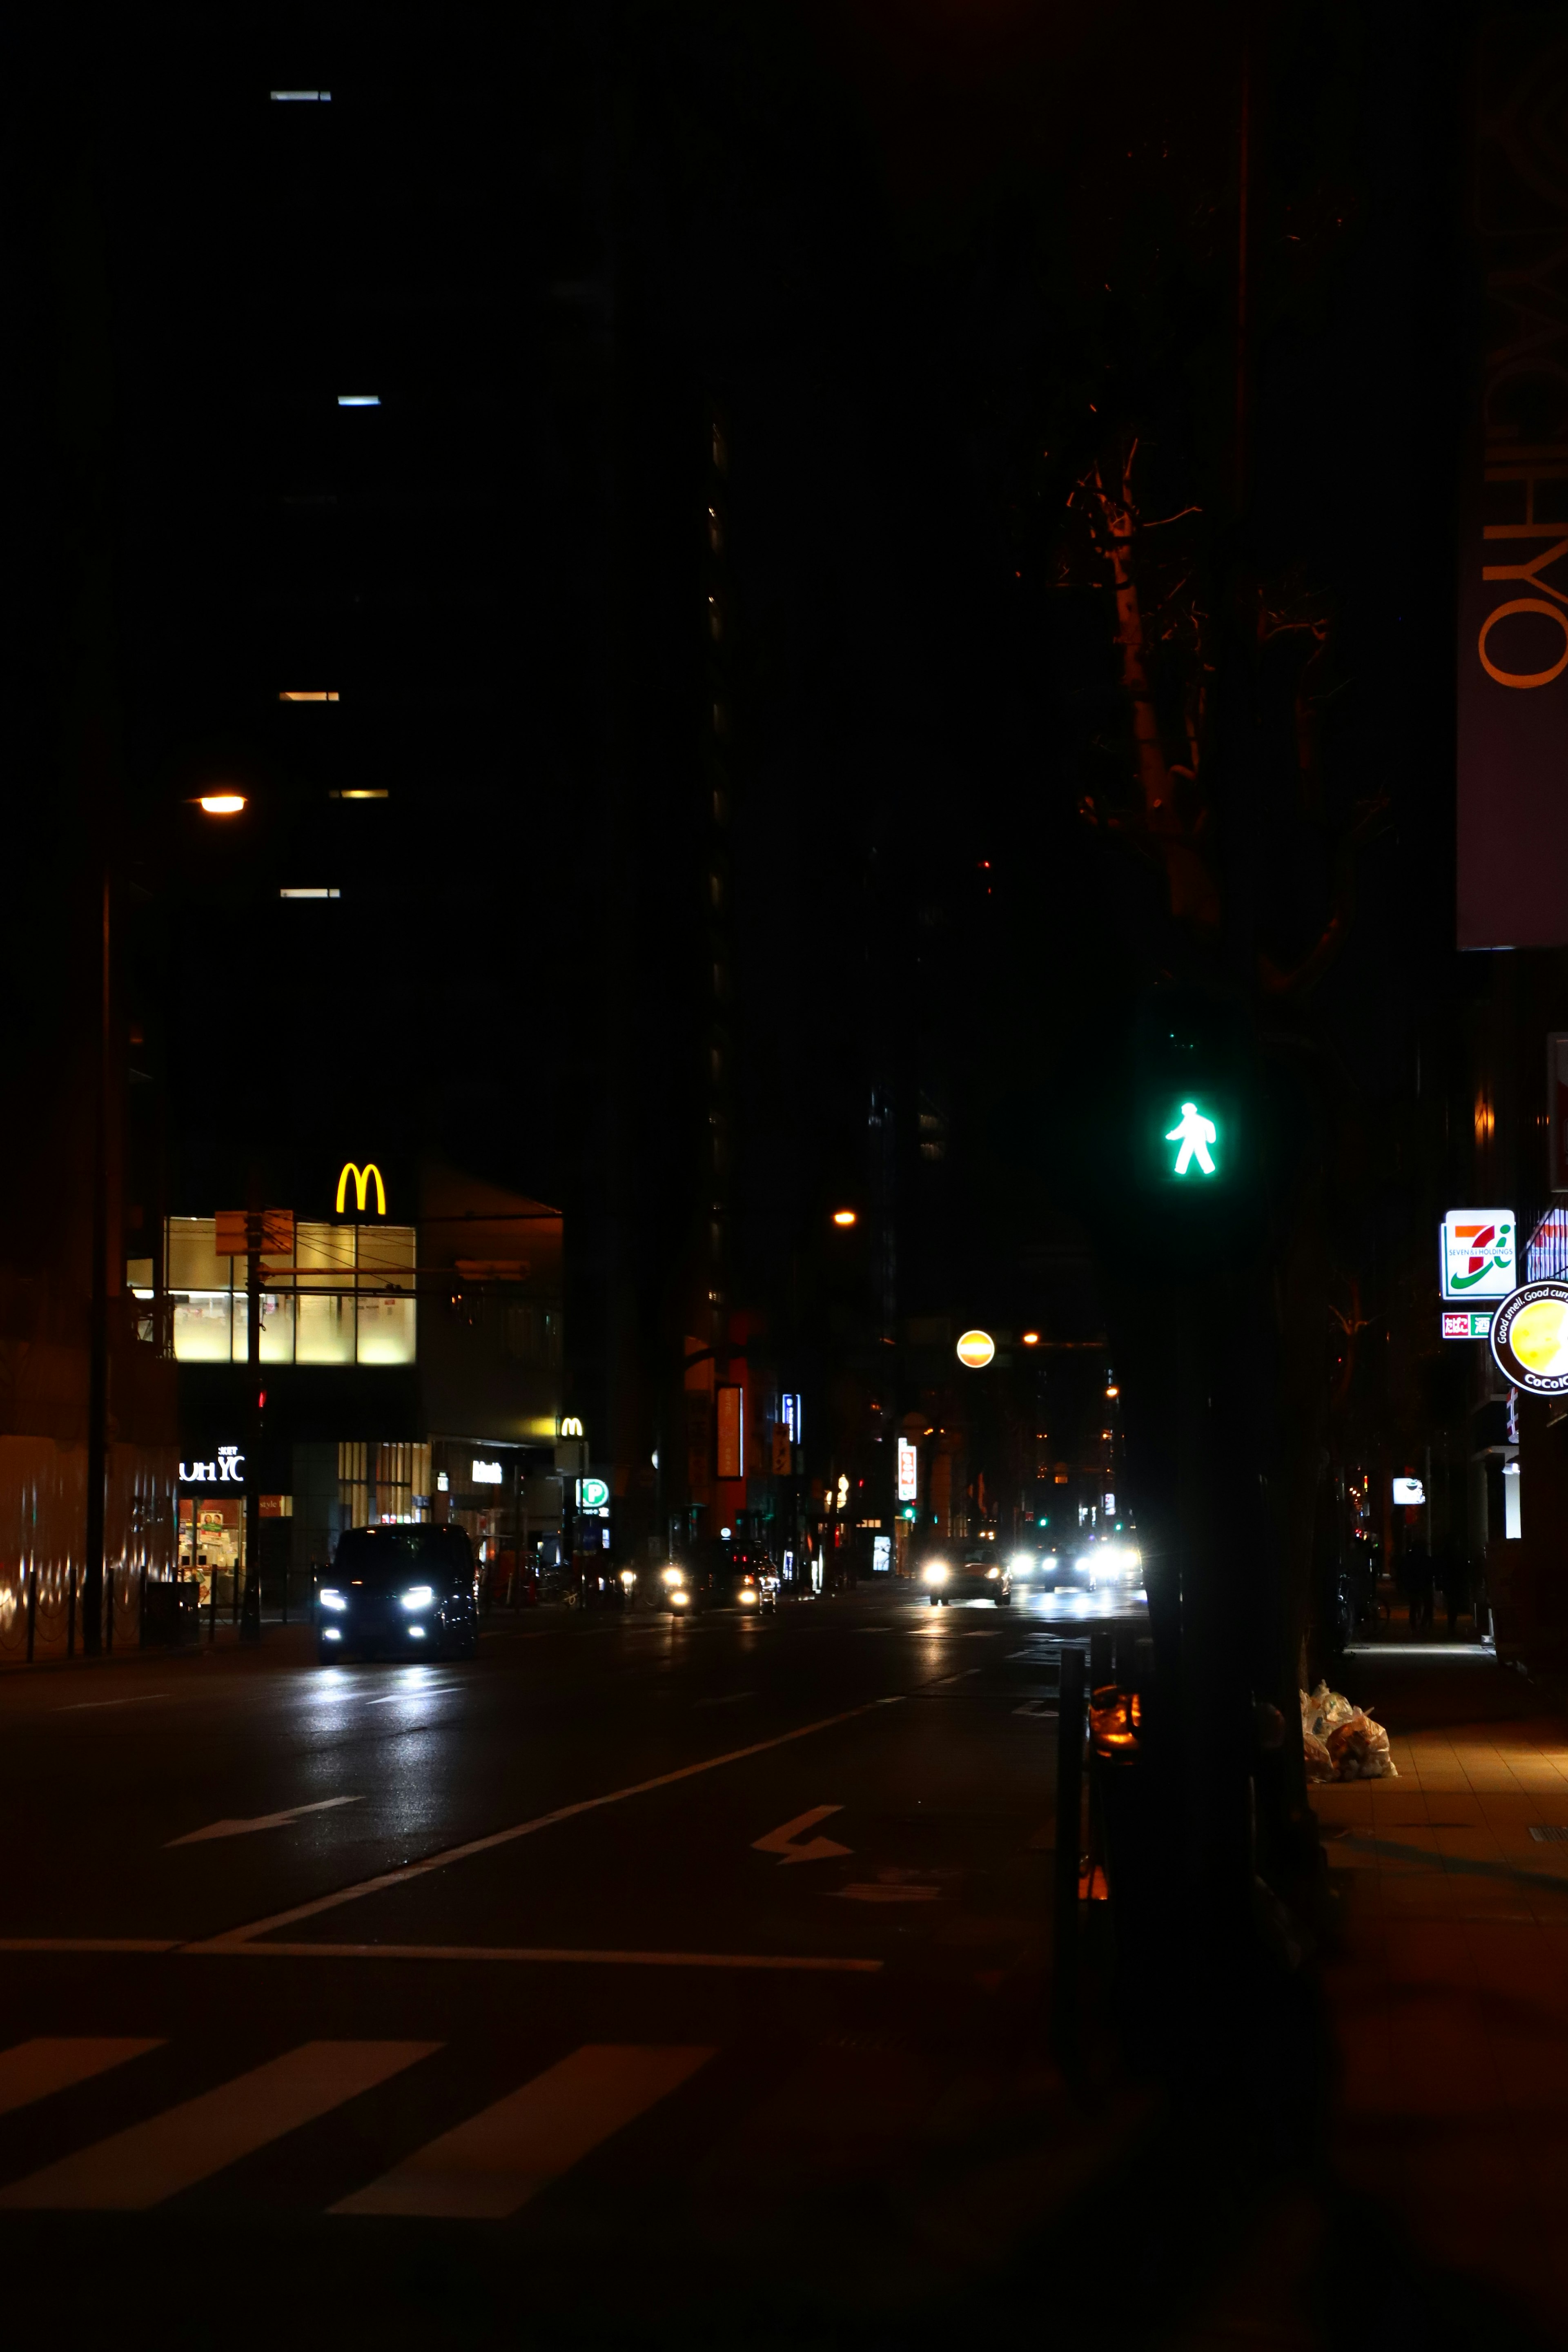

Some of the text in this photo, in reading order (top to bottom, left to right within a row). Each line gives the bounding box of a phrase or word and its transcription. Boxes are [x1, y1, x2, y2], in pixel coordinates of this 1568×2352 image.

[1497, 1287, 1568, 1344] Good smell. Good curr
[1445, 1317, 1468, 1333] たばこ
[1474, 1317, 1490, 1334] 酒
[588, 1484, 603, 1503] P
